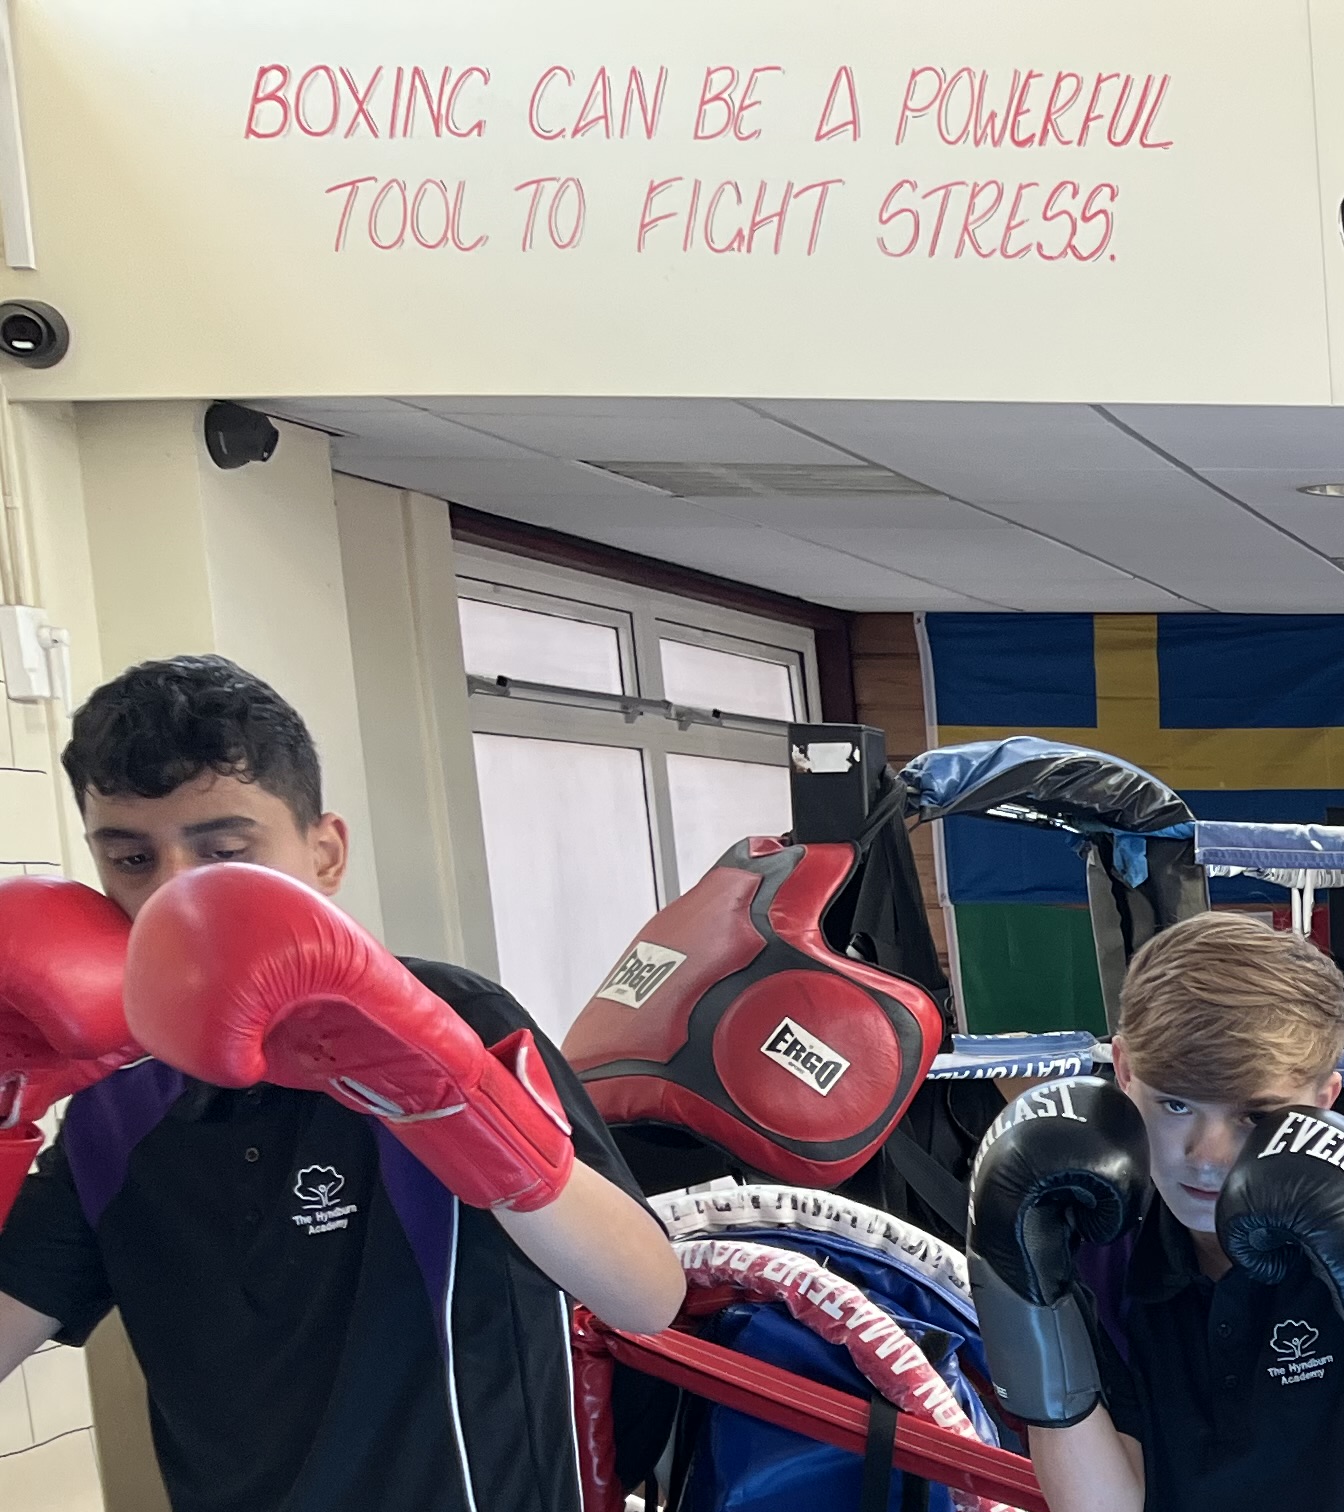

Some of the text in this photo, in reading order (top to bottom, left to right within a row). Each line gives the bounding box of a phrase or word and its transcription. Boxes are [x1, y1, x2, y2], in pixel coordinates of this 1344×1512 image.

[243, 62, 1174, 150] BOXING CAN BE A POWERFUL
[323, 176, 1118, 264] TOOL TO FIGHT STRESS.
[611, 948, 677, 1002] ERGO
[766, 1023, 843, 1090] ERGO
[293, 1213, 312, 1226] The
[308, 1217, 348, 1235] Academy
[1267, 1354, 1334, 1379] The Hyndburn
[1281, 1367, 1325, 1386] Academy
